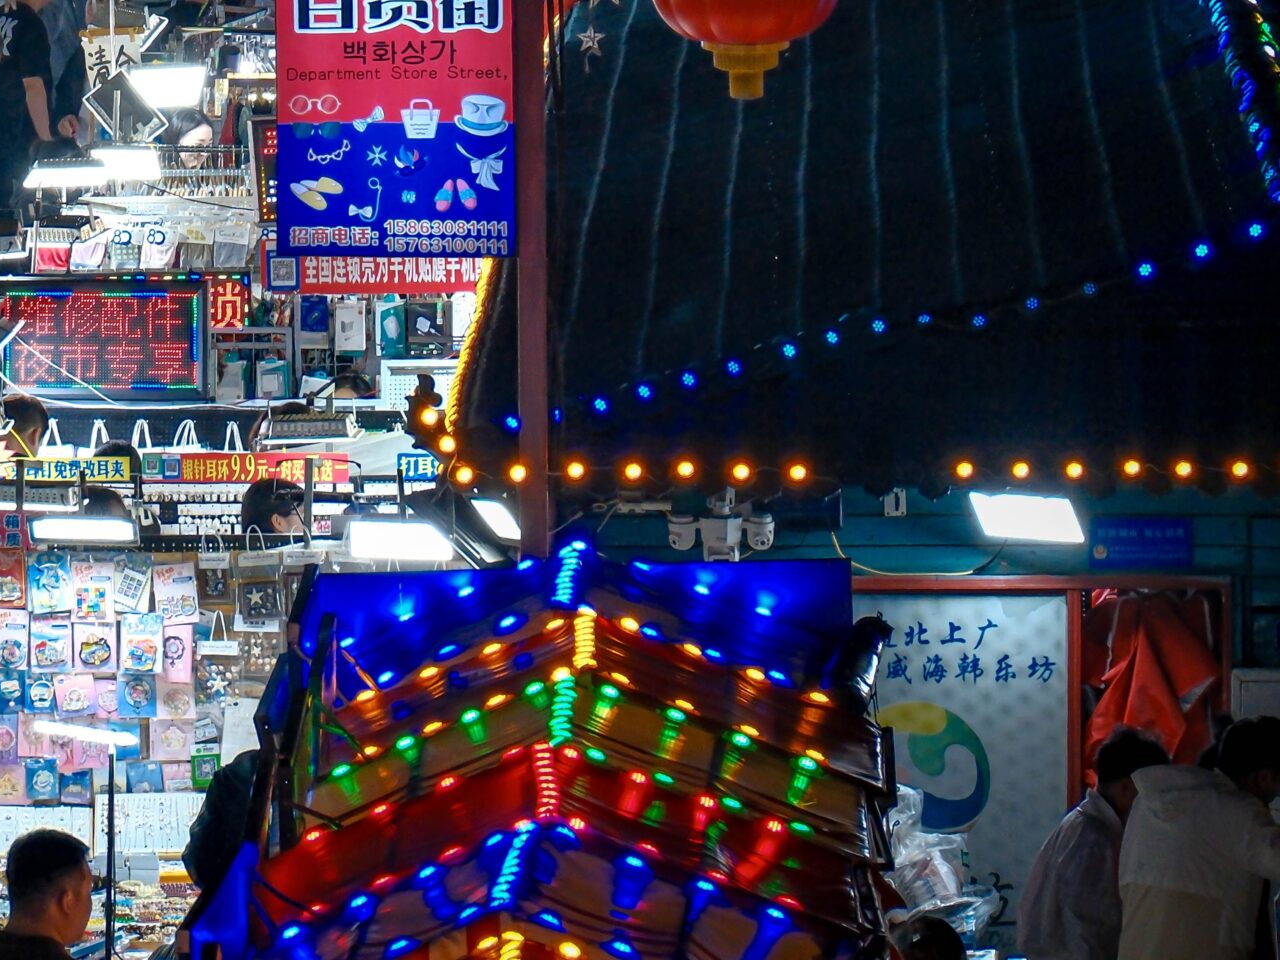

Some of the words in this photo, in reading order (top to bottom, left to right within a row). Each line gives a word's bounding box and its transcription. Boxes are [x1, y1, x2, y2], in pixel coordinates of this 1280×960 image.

[343, 40, 457, 65] 백화상가
[286, 68, 381, 82] Department
[391, 67, 438, 80] Store
[384, 219, 508, 237] 15863081111
[384, 237, 508, 254] 15763100111
[15, 340, 188, 383] 夜市专享
[400, 455, 442, 478] 打耳
[882, 619, 999, 649] 北上广
[886, 654, 1058, 685] 威海韩乐坊
